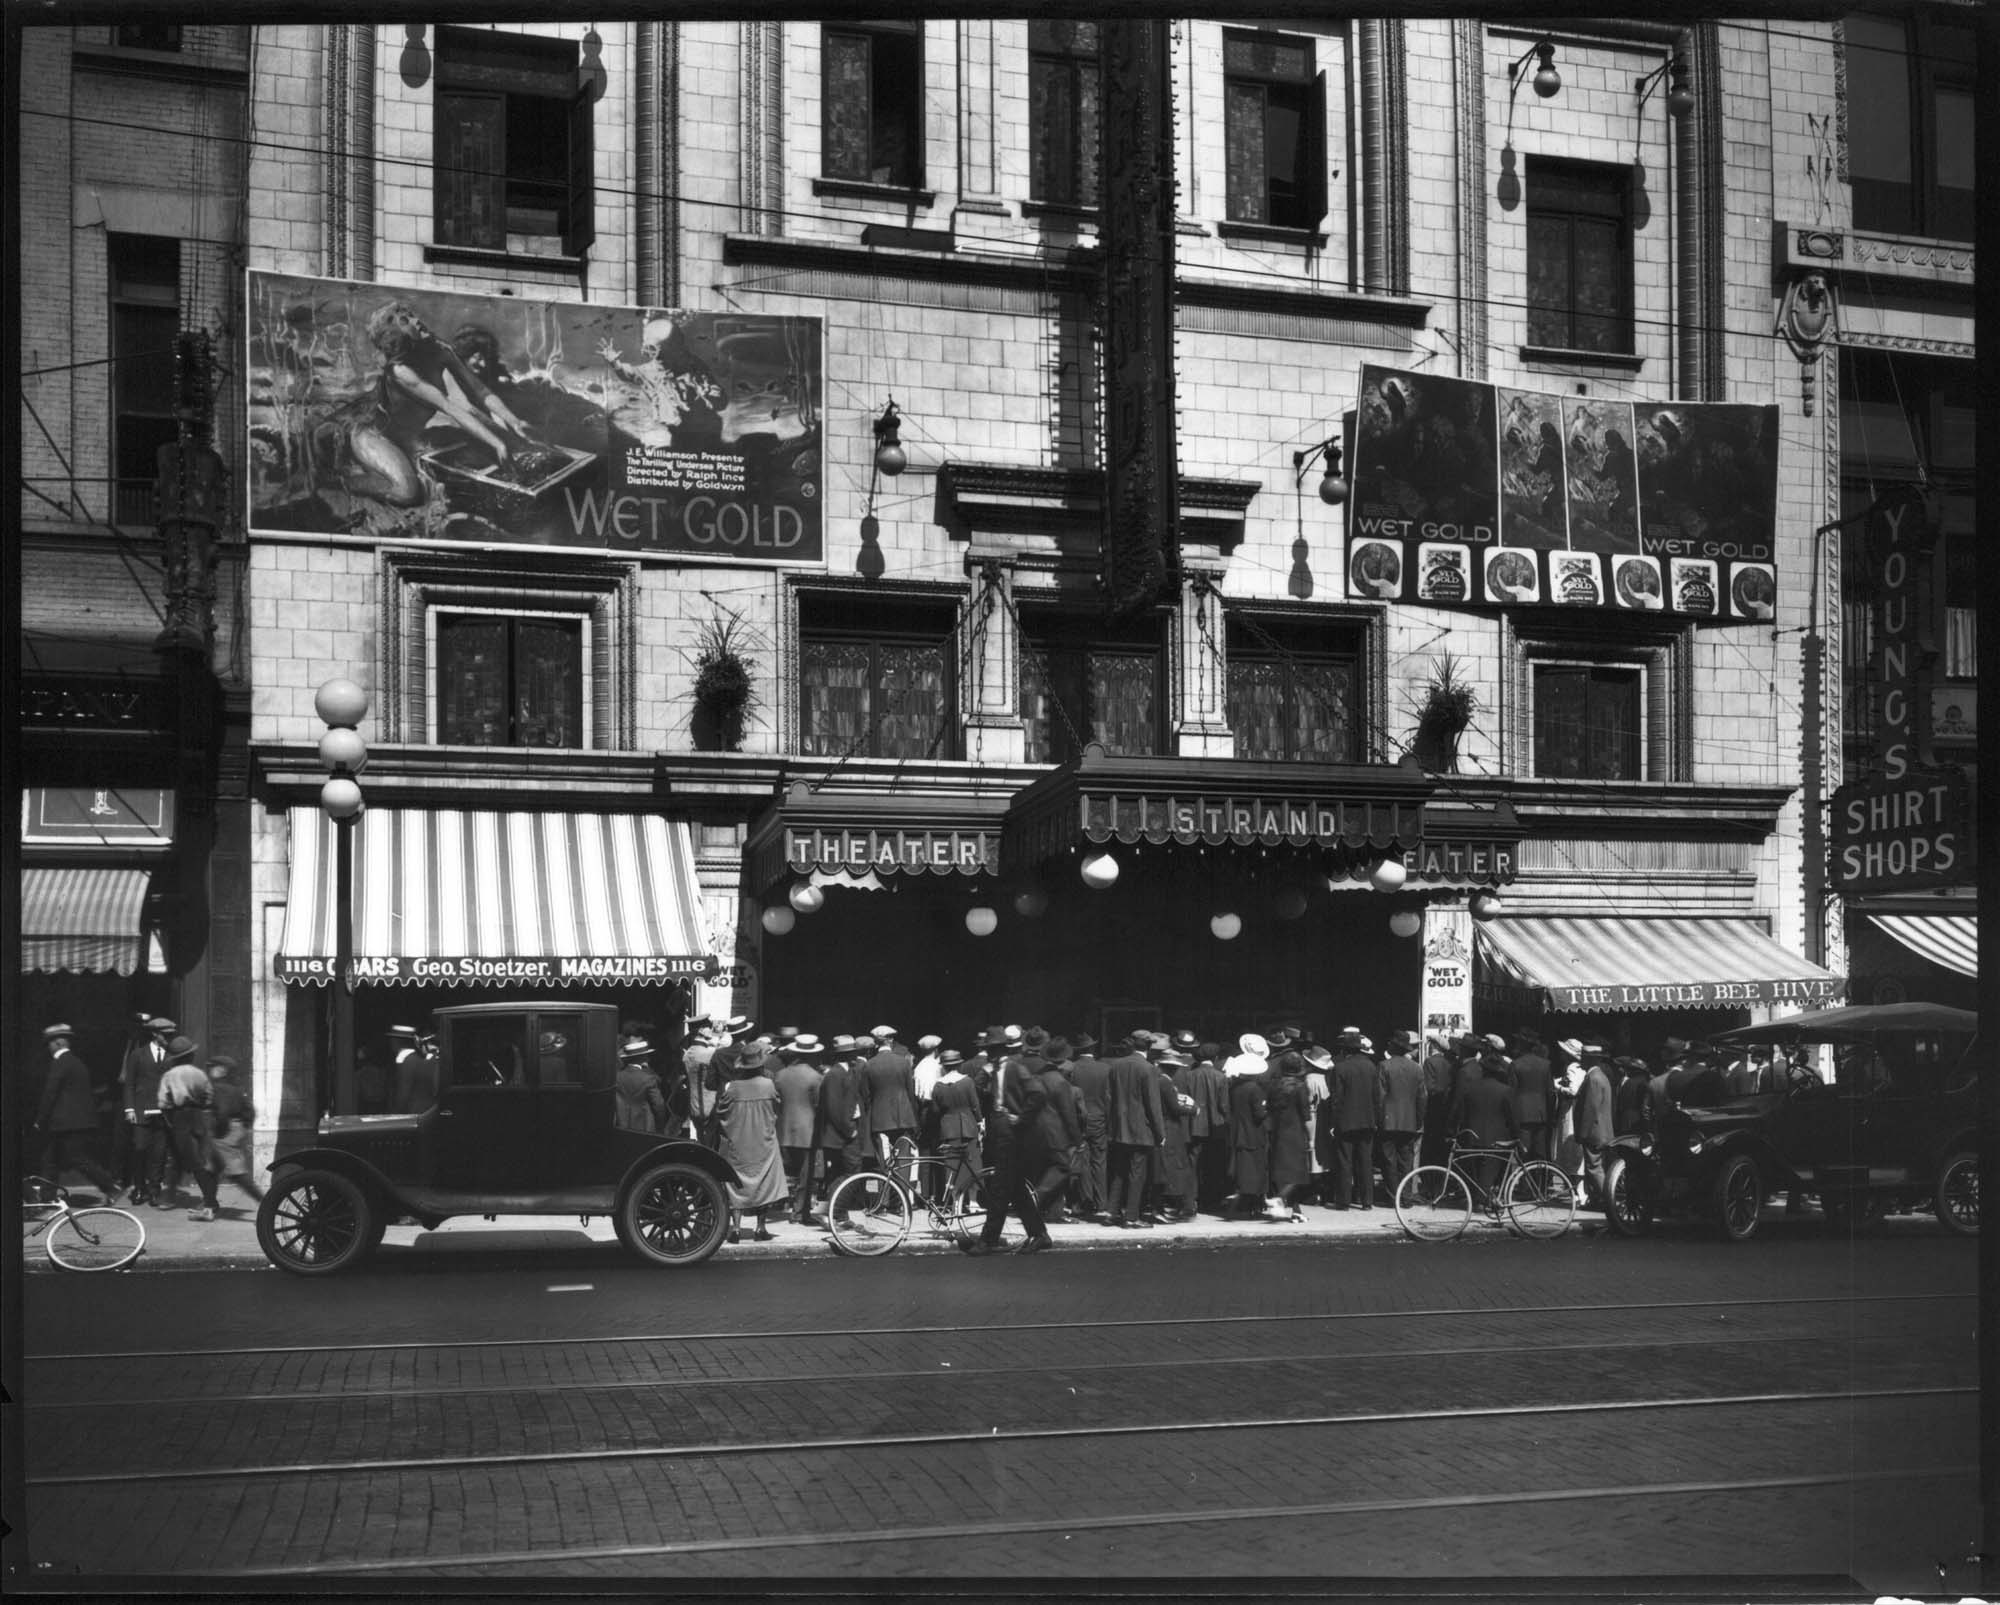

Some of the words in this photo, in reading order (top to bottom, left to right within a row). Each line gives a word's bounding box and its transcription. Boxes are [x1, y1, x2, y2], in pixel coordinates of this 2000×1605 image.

[627, 457, 641, 465] The
[641, 457, 674, 470] Thrilling
[676, 460, 714, 470] Undersea
[716, 462, 745, 472] Picture
[644, 448, 698, 460] Williamson
[701, 452, 745, 463] Presents
[626, 466, 668, 477] Directed
[671, 469, 682, 479] by
[686, 469, 718, 481] Ralph
[722, 472, 745, 482] Ince
[627, 476, 679, 487] Distributed
[682, 480, 693, 490] by
[696, 480, 745, 492] Goldwyn
[564, 486, 668, 540] WET
[684, 496, 803, 547] GOLD
[1358, 517, 1414, 536] WET
[1421, 522, 1492, 542] GOLD
[1644, 537, 1696, 554] WET
[1703, 541, 1769, 560] GOLD
[21, 690, 140, 719] PANY
[1176, 808, 1336, 836] STRAND
[1846, 785, 1948, 835] SHIRT
[794, 838, 977, 866] THEATER
[1402, 850, 1511, 875] EATER
[1842, 833, 1956, 881] SHOPS
[285, 959, 324, 973] 1116
[412, 957, 456, 977] Geo.
[460, 958, 551, 977] Stoetzer.
[561, 958, 667, 977] MAGAZINES
[671, 960, 706, 972] 1116
[1566, 988, 1613, 1005] THE
[1621, 985, 1703, 1004] LITTLE
[1714, 983, 1761, 1001] BEE
[1773, 981, 1835, 999] HIVE
